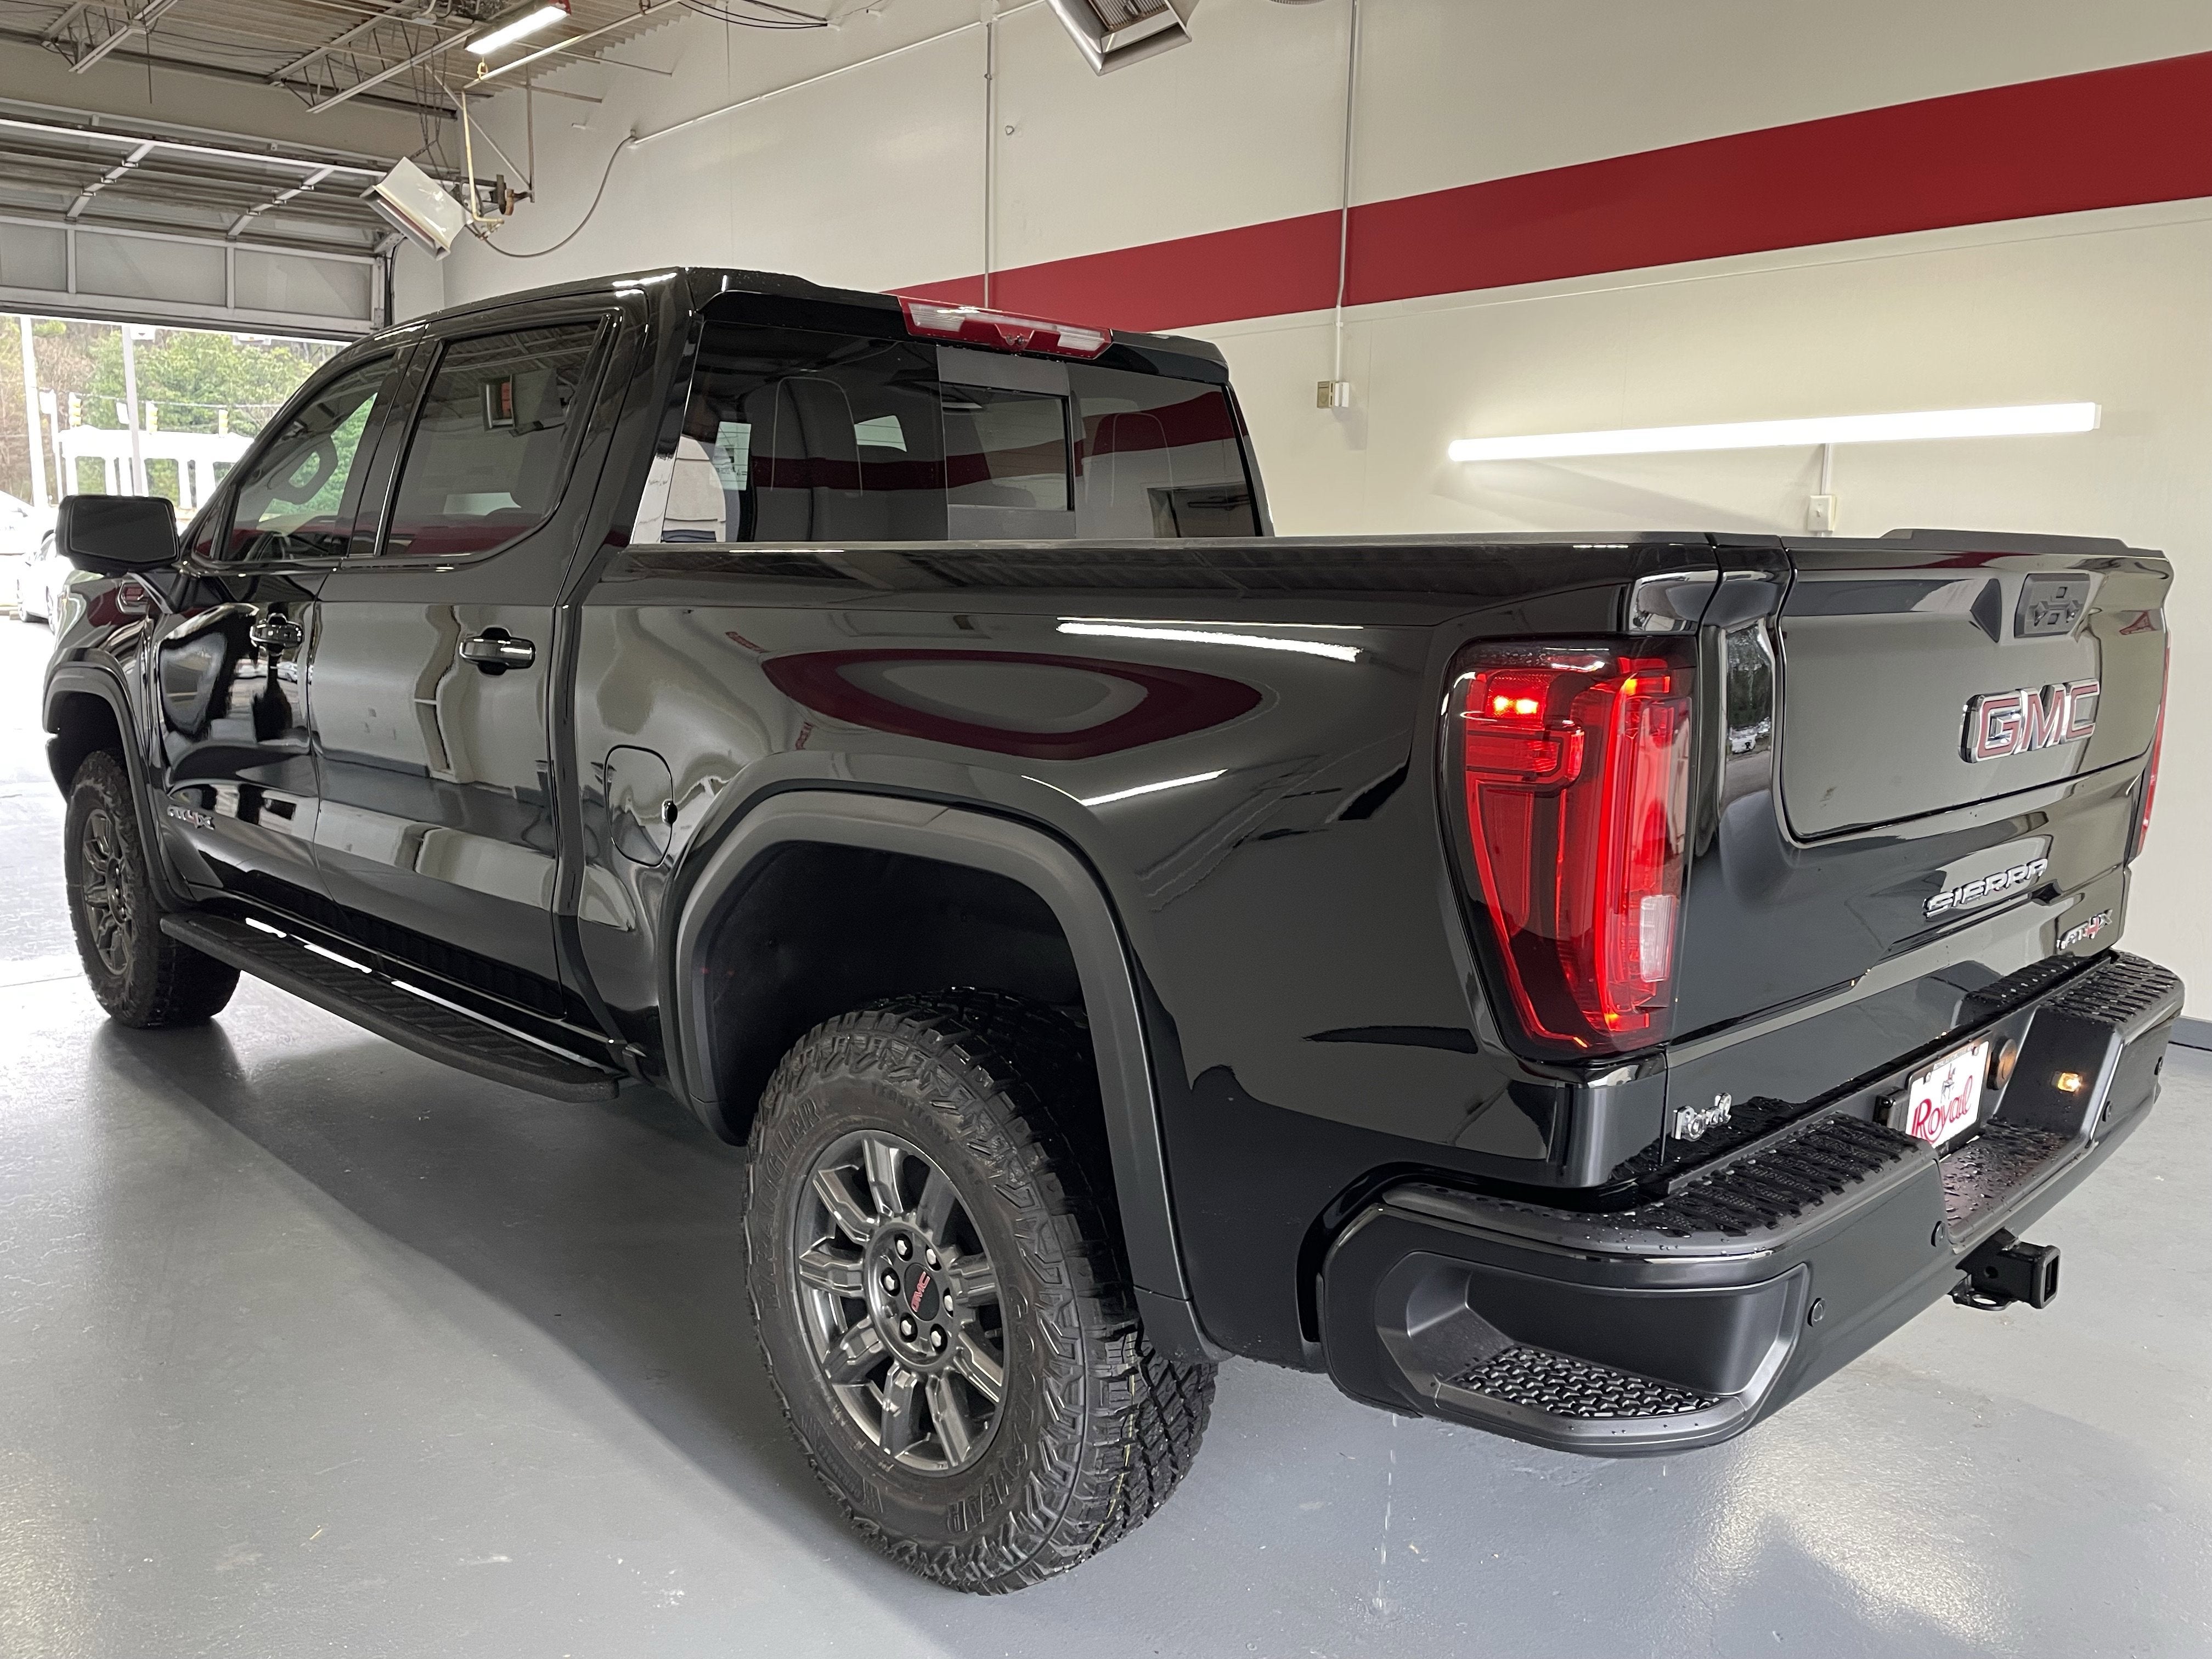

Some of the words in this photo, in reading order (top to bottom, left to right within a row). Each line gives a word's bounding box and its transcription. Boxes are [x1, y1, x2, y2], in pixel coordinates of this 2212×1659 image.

[1960, 678, 2100, 763] GMC
[1922, 857, 2048, 921] SIERRA
[2057, 909, 2113, 950] AT4X
[1911, 1075, 1973, 1145] Royal
[911, 1271, 930, 1312] GMC
[947, 1285, 1037, 1534] GOODYEAR
